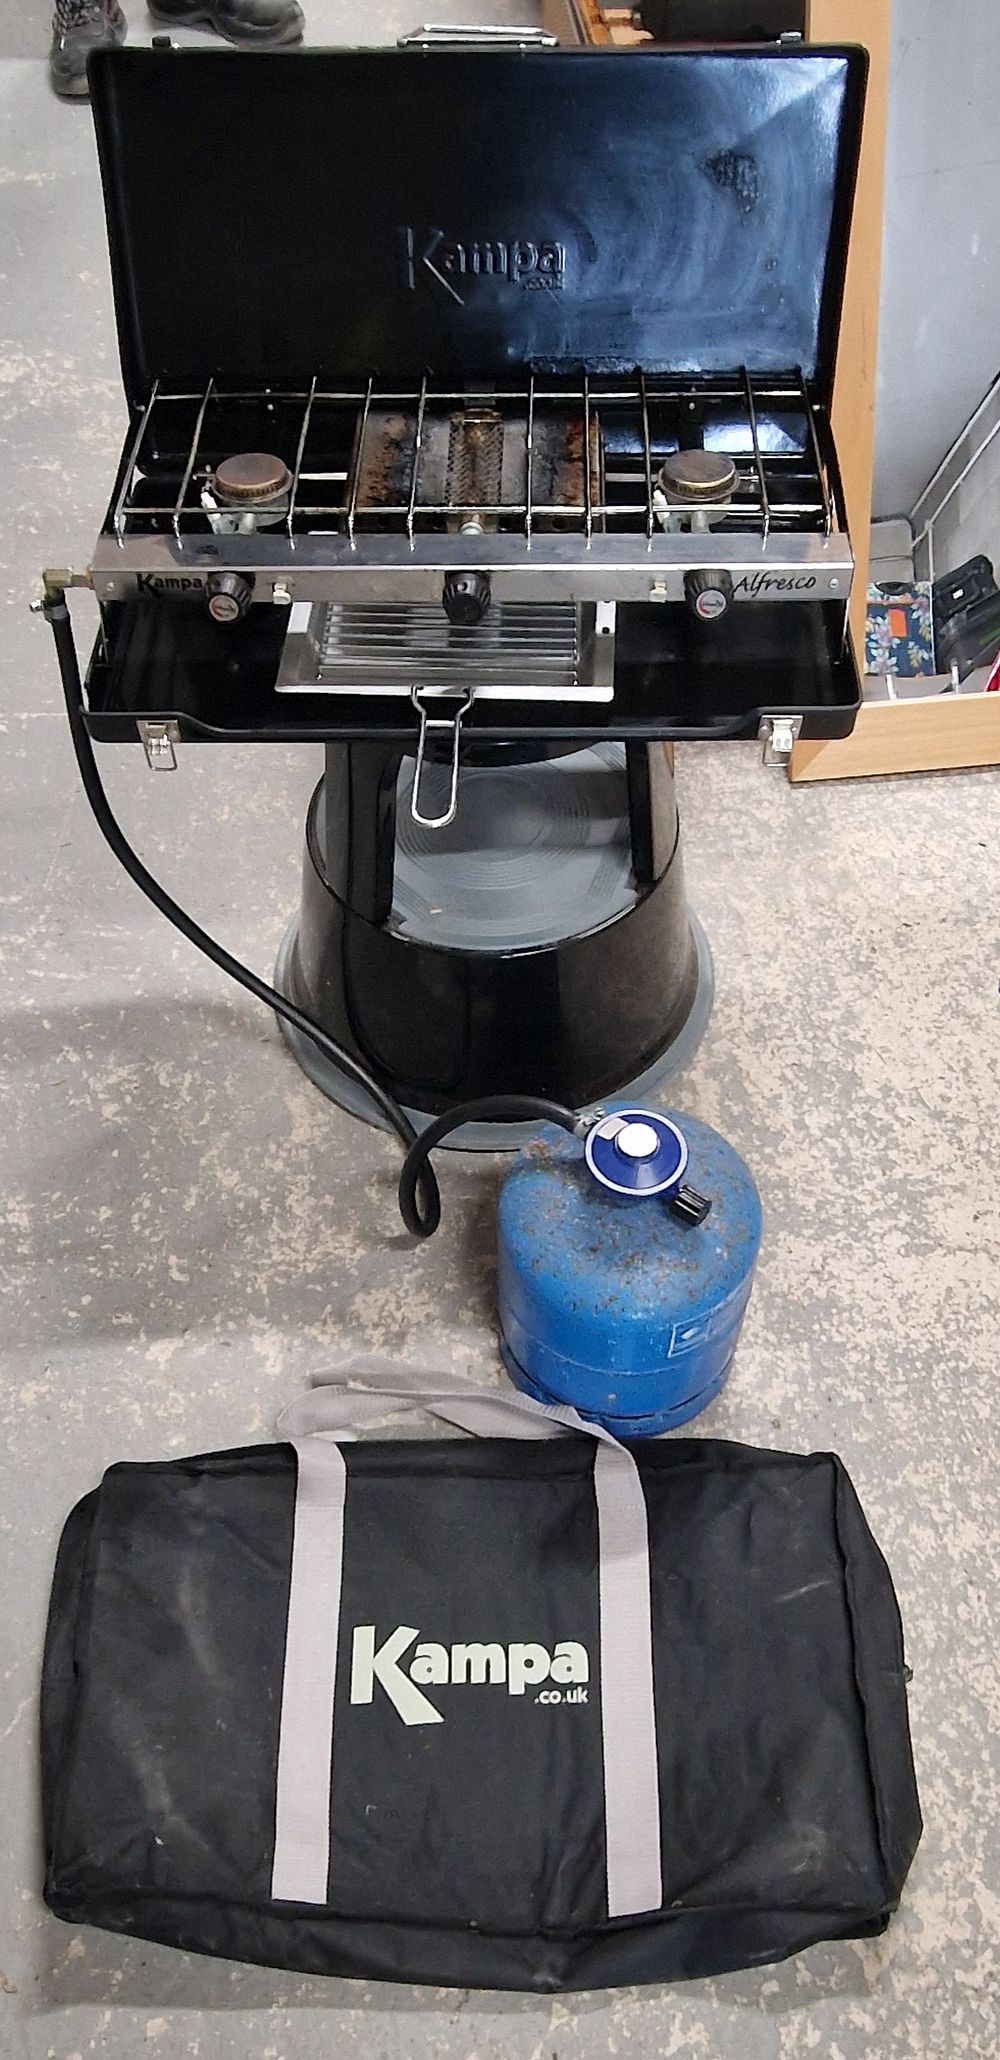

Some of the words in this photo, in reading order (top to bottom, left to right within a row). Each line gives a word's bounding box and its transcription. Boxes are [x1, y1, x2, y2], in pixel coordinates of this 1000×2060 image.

[399, 226, 566, 305] Kampa
[136, 573, 203, 597] Kampa
[733, 571, 816, 597] Alfresco
[350, 1624, 589, 1725] Kampa
[534, 1686, 589, 1704] .co.uk
